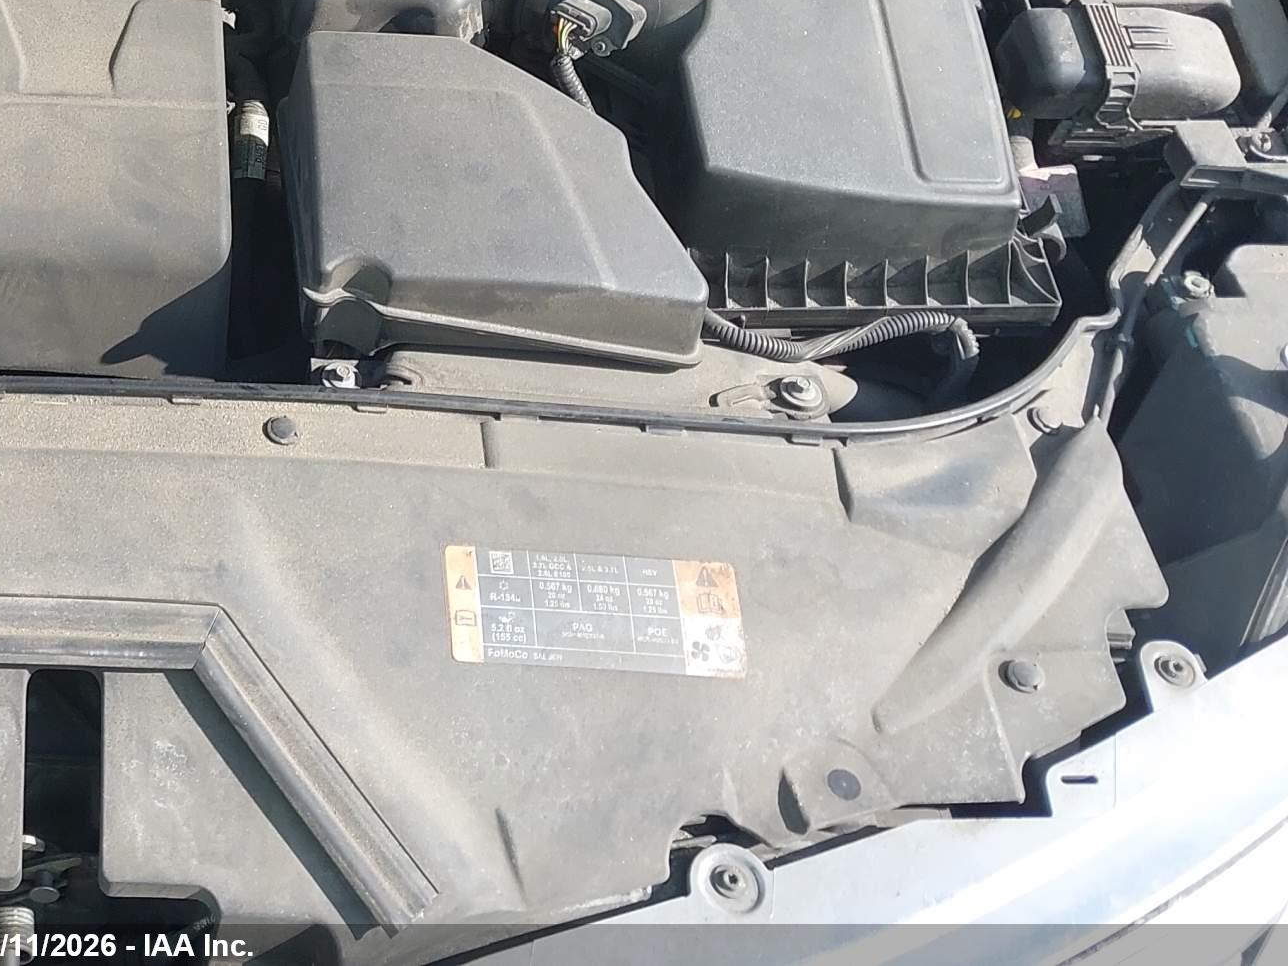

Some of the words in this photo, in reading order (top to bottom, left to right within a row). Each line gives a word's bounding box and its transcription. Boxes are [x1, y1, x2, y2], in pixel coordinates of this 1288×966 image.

[561, 583, 573, 594] kg
[609, 586, 621, 596] kg
[491, 624, 504, 632] 5.2
[573, 622, 593, 632] PAG
[647, 627, 668, 637] POE
[513, 634, 527, 643] cc)
[487, 648, 529, 659] FoMoCo
